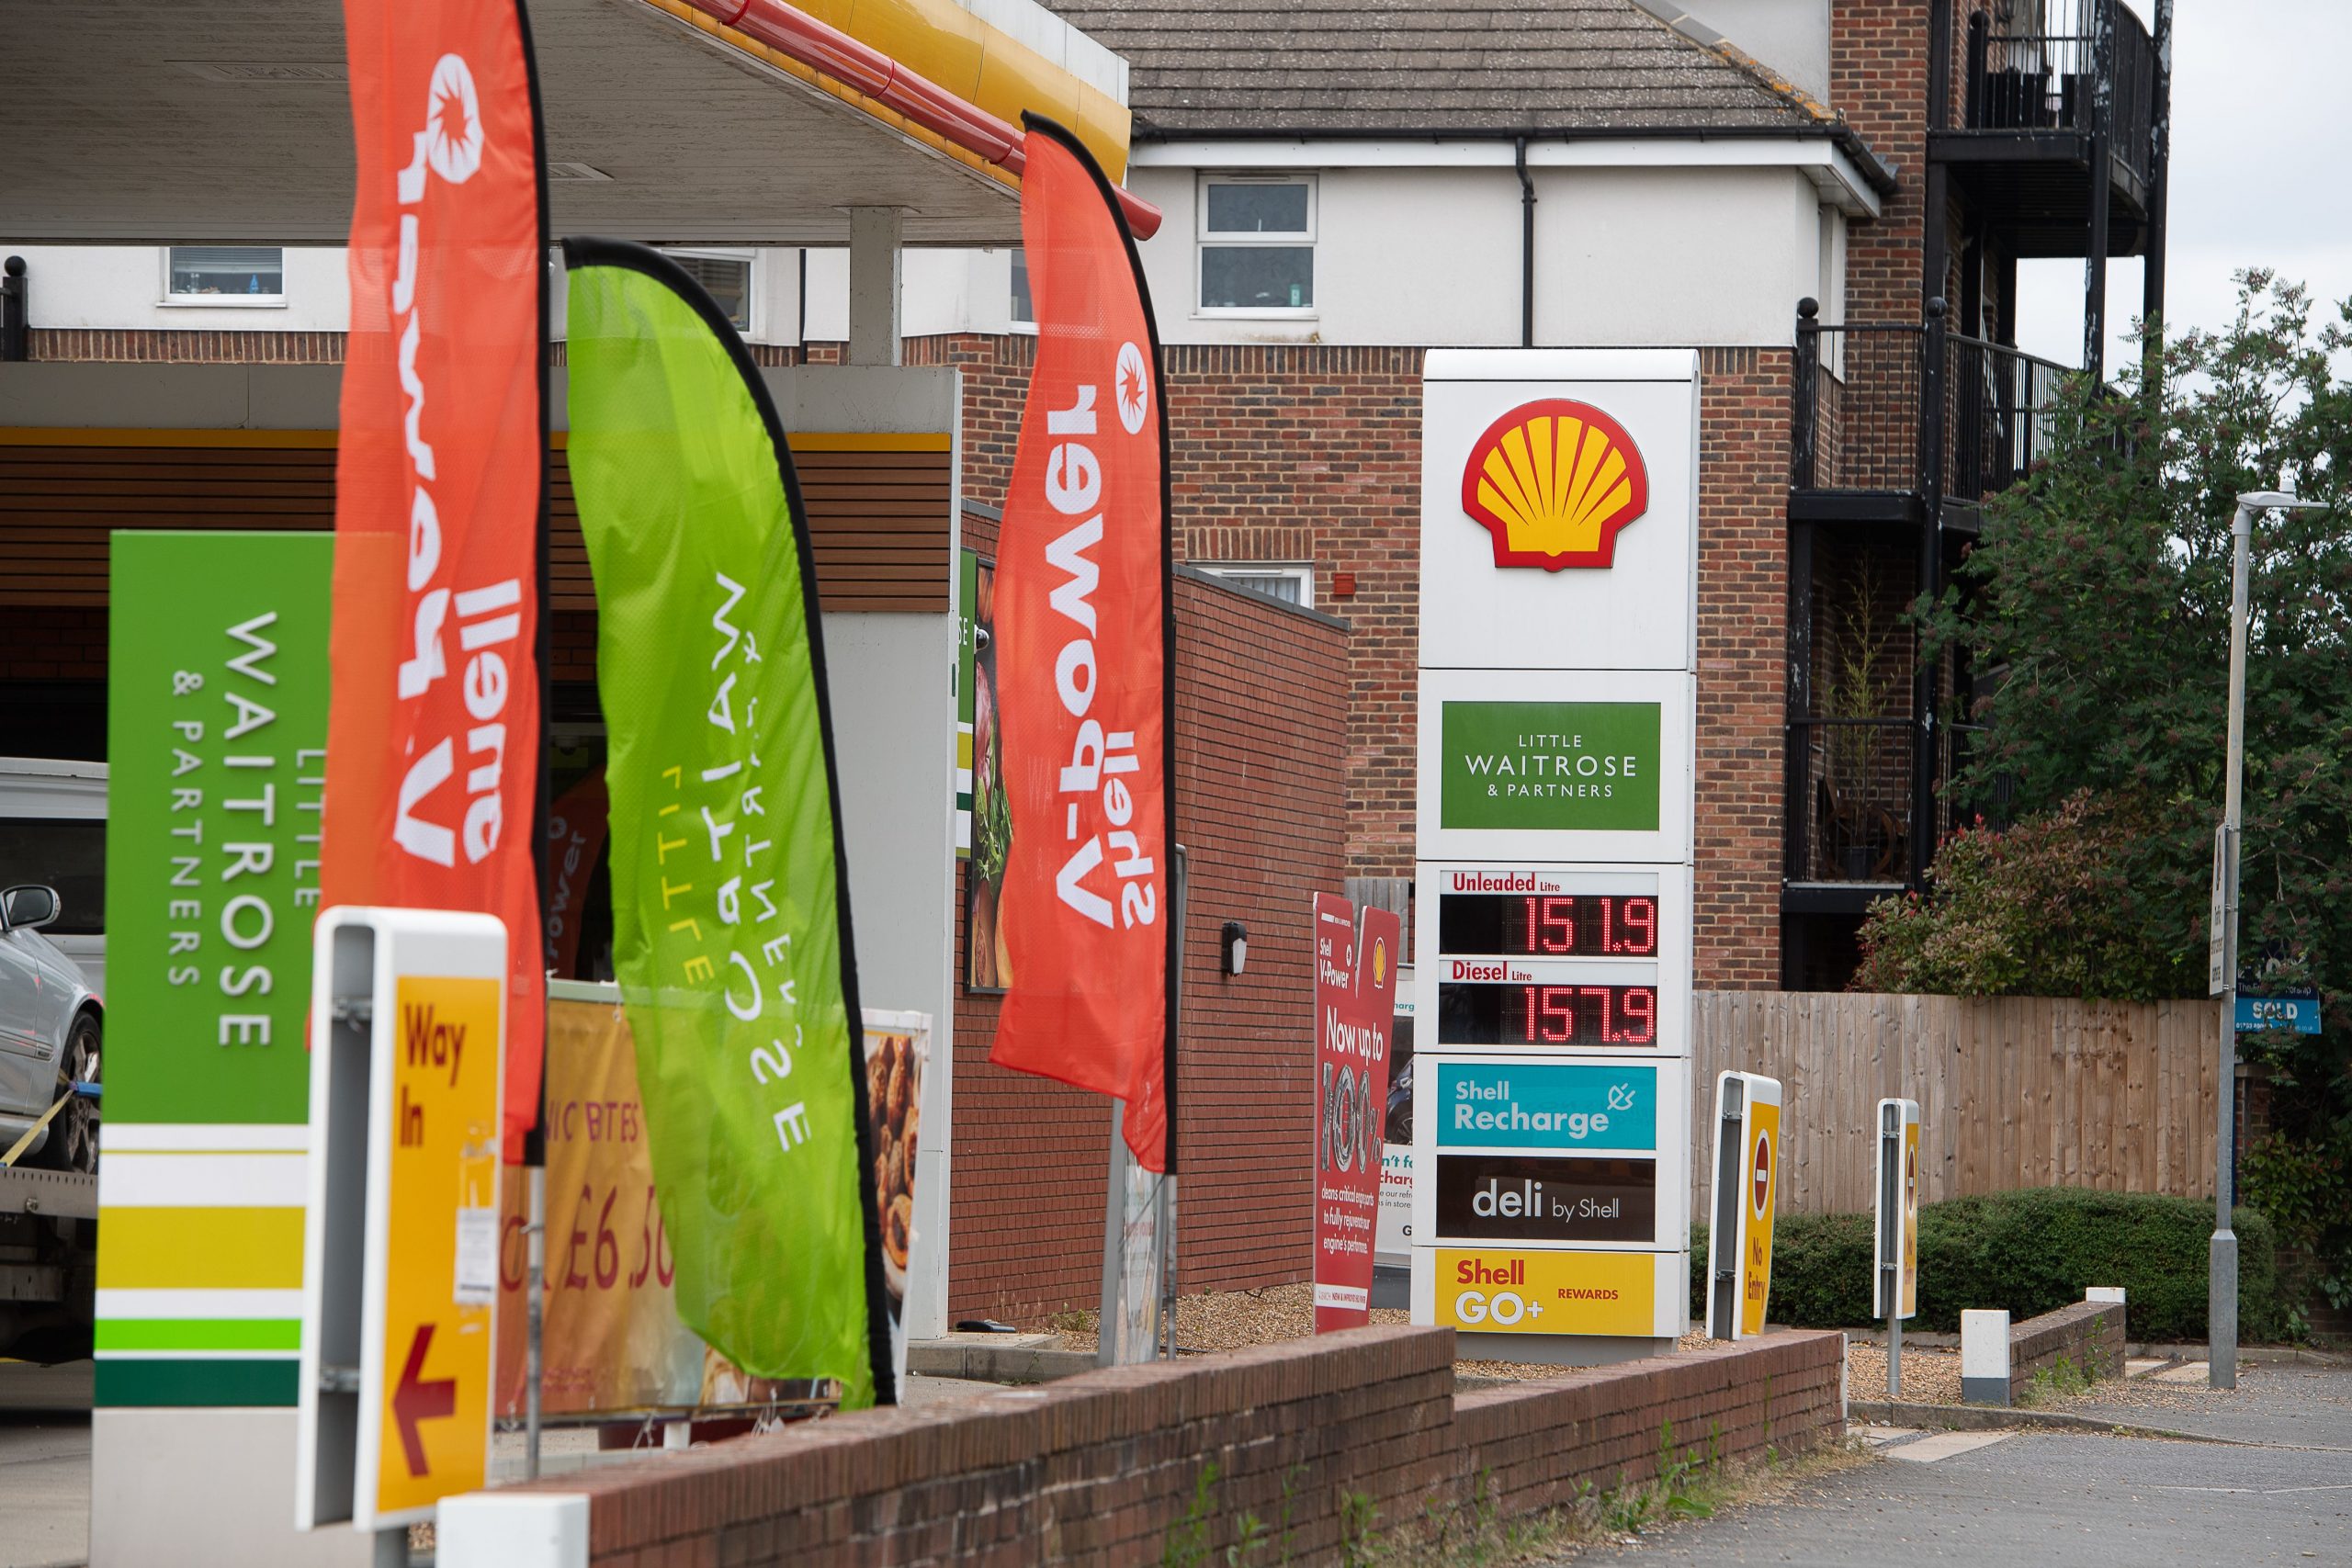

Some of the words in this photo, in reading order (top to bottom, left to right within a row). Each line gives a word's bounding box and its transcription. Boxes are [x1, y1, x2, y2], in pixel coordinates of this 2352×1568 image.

[172, 670, 204, 695] &
[1519, 734, 1582, 748] LITTLE
[1464, 755, 1636, 777] WAITROSE
[1487, 784, 1498, 796] &
[1508, 784, 1613, 797] PARTNERS
[219, 611, 277, 1045] WAITROSE
[168, 720, 204, 987] PARTNERS
[1453, 872, 1536, 892] Unleaded
[1540, 882, 1560, 892] Litre
[1525, 897, 1655, 953] 151.9
[1319, 937, 1332, 957] Shell
[1319, 958, 1350, 988] V-Power
[1453, 959, 1508, 981] Diesel
[1511, 971, 1532, 982] Litre
[1525, 986, 1655, 1044] 157.9
[402, 1004, 467, 1089] Way
[1326, 1004, 1356, 1055] Now
[1358, 1027, 1371, 1066] up
[1373, 1021, 1384, 1062] to
[1456, 1080, 1510, 1100] Shell
[400, 1085, 424, 1147] In
[1321, 1061, 1382, 1174] 100%
[1454, 1101, 1610, 1140] Recharge
[1394, 1201, 1411, 1209] store
[1472, 1179, 1543, 1217] deli
[1553, 1197, 1576, 1224] by
[1578, 1197, 1619, 1218] Shell
[1329, 1206, 1343, 1231] fully
[1752, 1236, 1762, 1267] No
[1456, 1258, 1525, 1285] Shell
[1557, 1288, 1619, 1300] REWARDS
[1747, 1270, 1766, 1310] Entry
[1454, 1291, 1544, 1325] GO+
